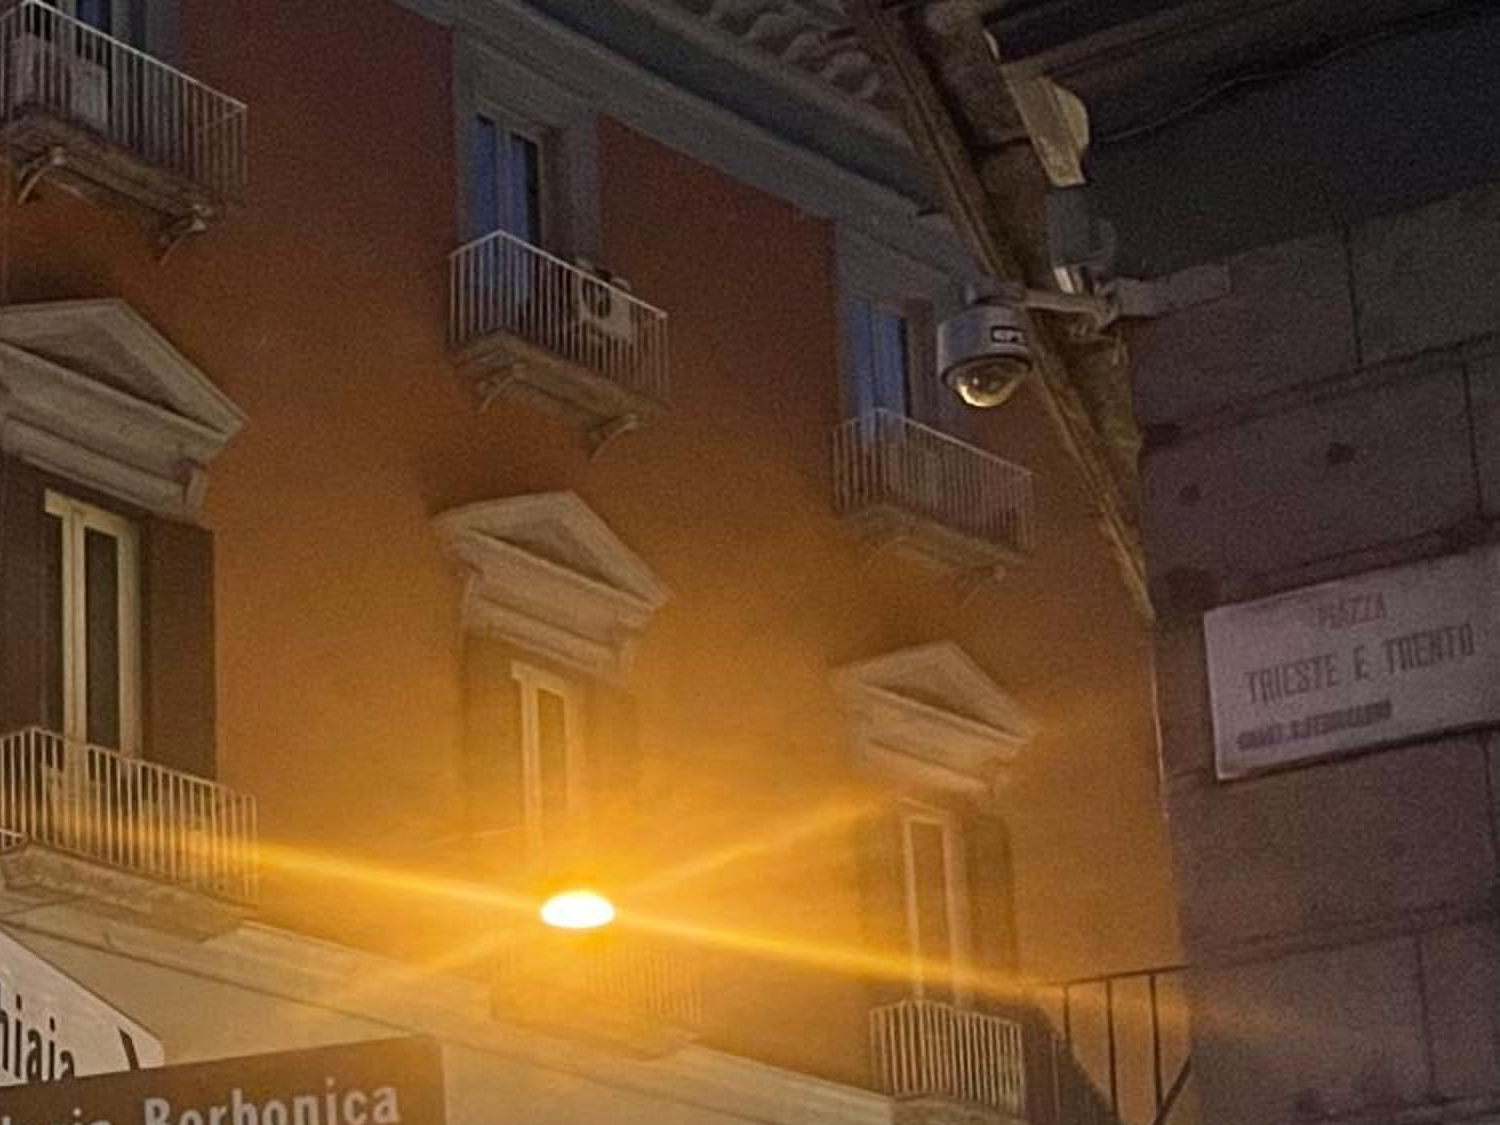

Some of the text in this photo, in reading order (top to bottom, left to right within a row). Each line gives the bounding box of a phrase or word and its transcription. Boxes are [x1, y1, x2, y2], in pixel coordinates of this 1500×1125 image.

[1246, 623, 1476, 705] TRIESTE E TRENTO
